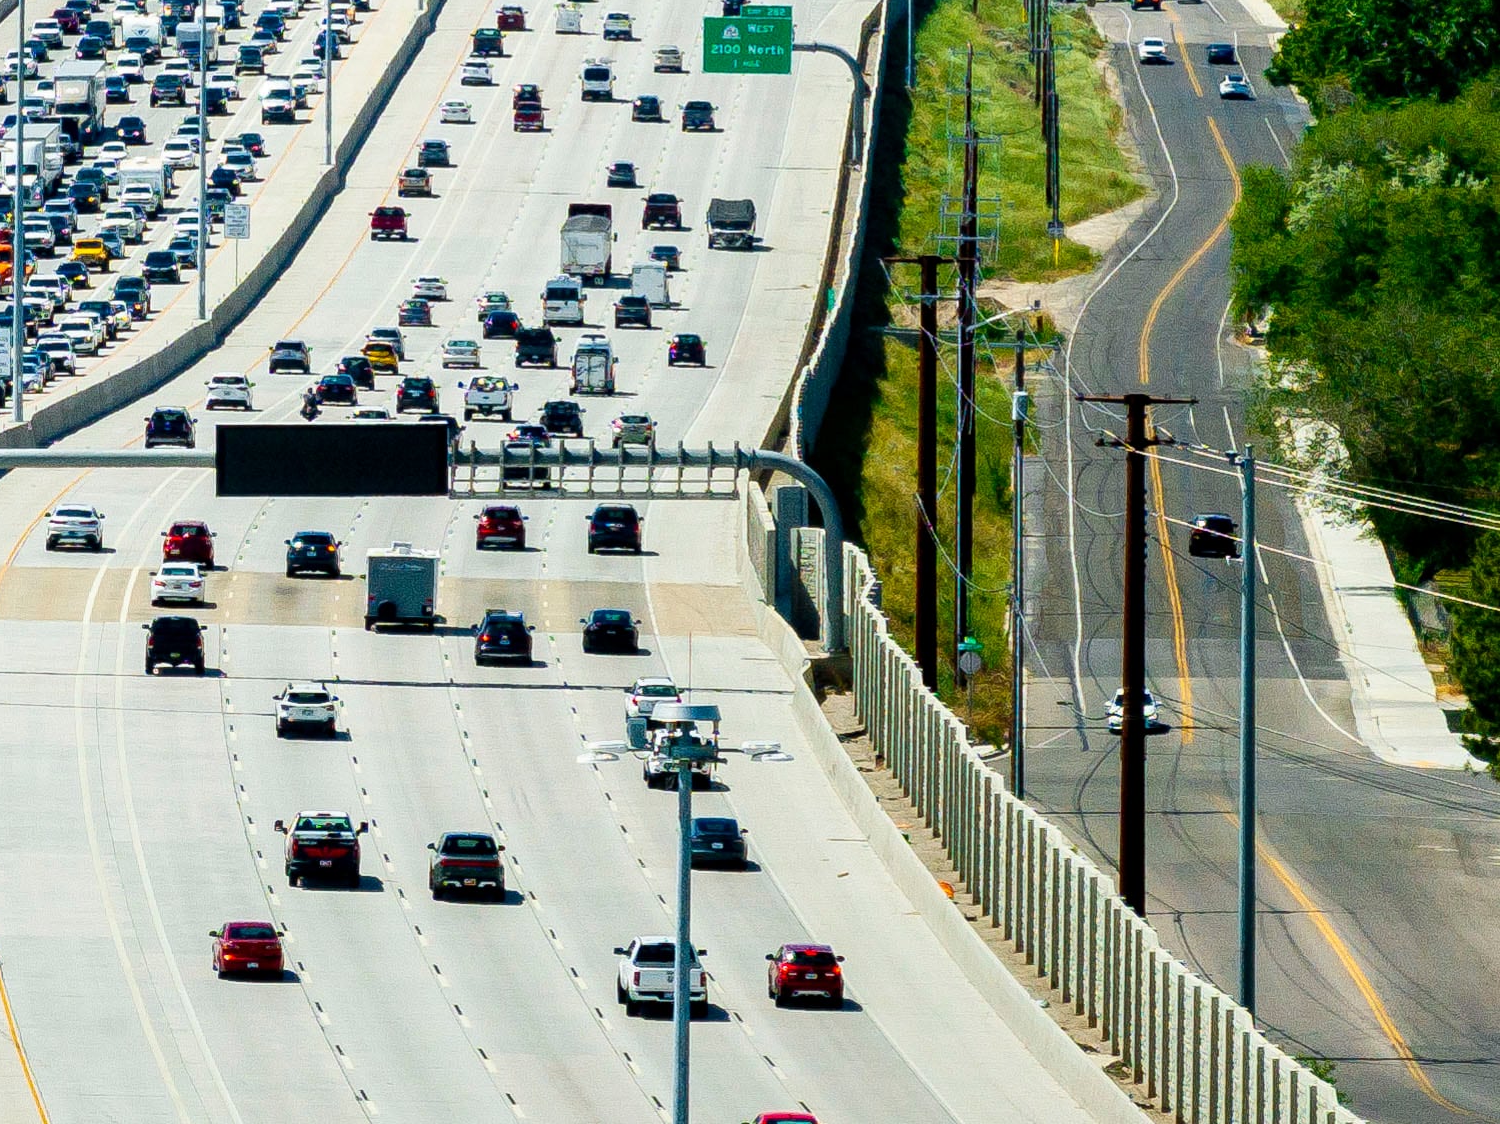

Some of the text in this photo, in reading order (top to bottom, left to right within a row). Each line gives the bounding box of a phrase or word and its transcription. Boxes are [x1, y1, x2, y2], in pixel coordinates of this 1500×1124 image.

[747, 23, 774, 34] WEST
[710, 43, 785, 55] 2100 North
